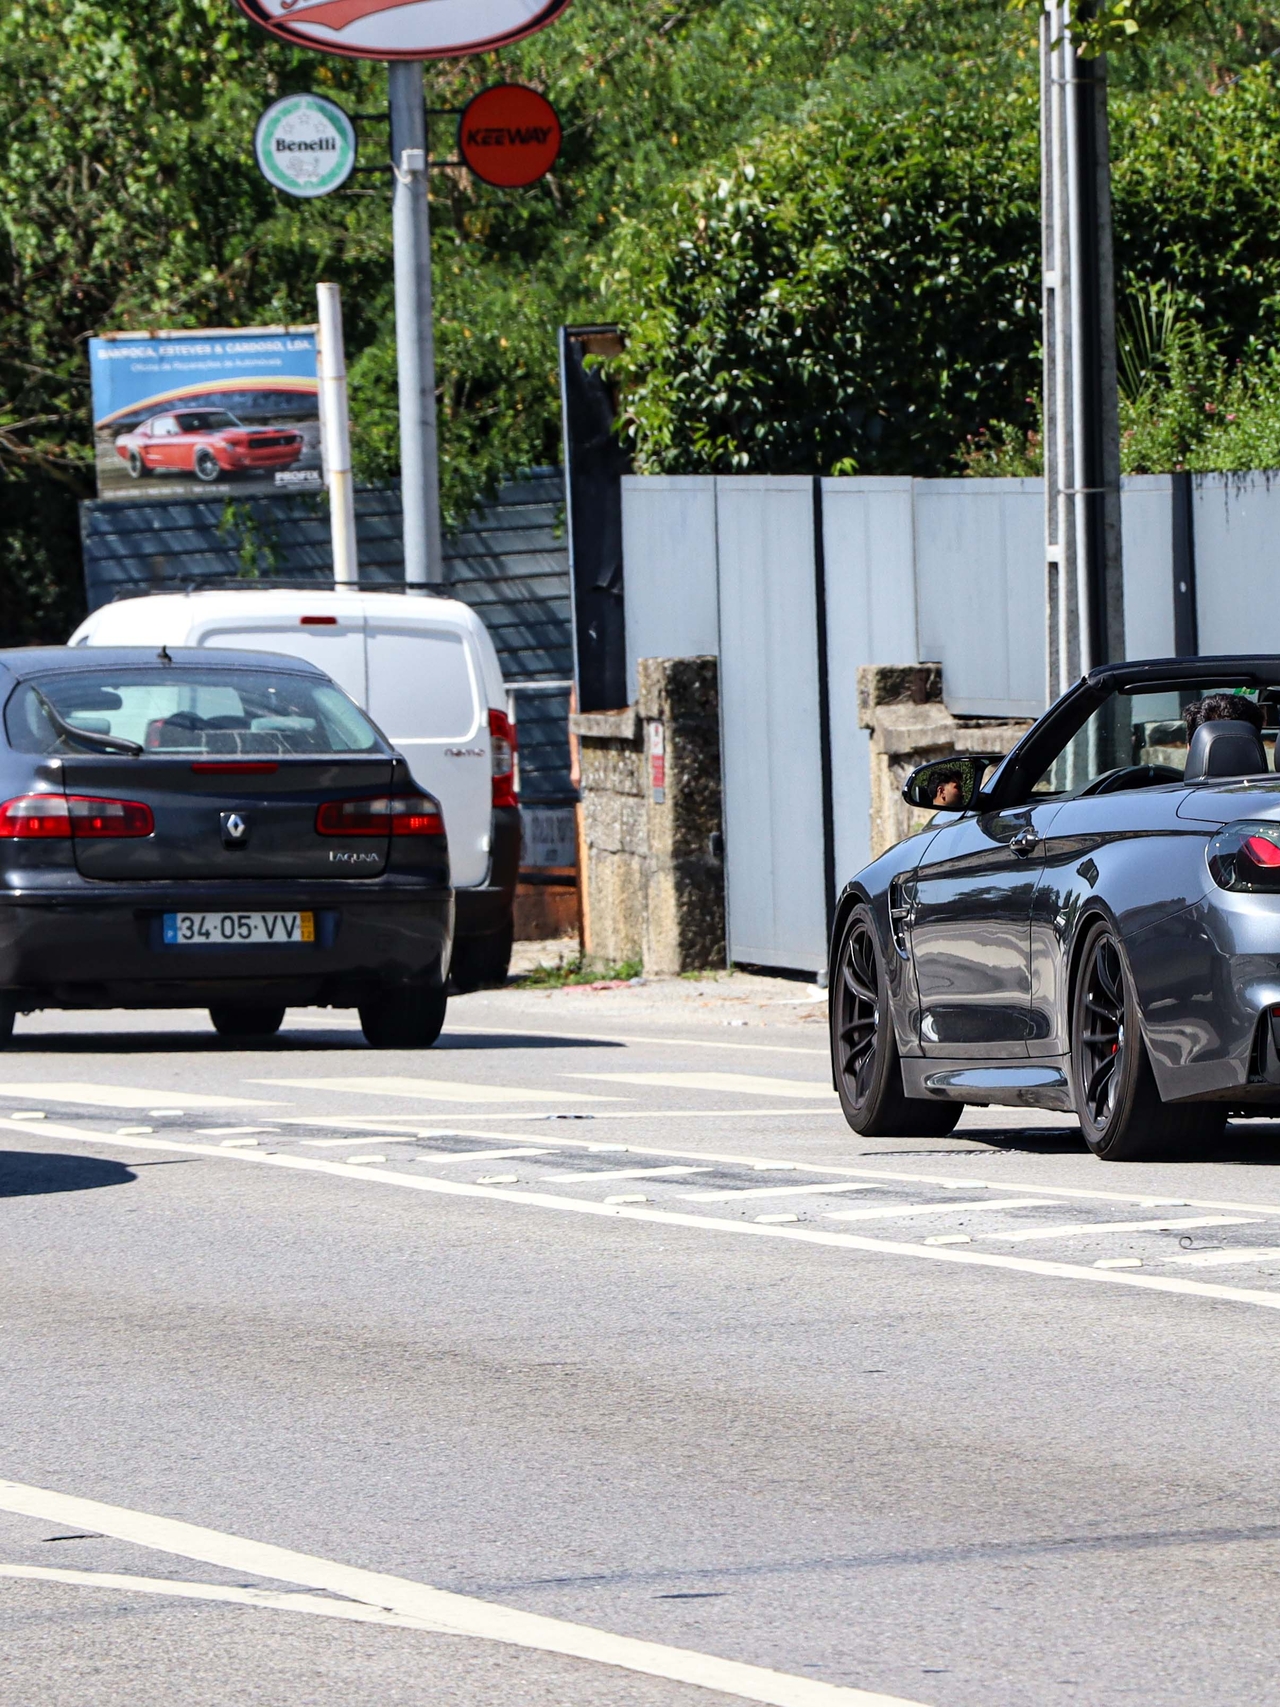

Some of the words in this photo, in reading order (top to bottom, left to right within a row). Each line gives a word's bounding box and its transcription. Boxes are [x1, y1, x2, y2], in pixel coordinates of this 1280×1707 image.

[275, 136, 336, 151] Benelli
[466, 127, 552, 147] KEEWAY
[215, 343, 223, 354] &
[329, 851, 379, 863] LAGUNA
